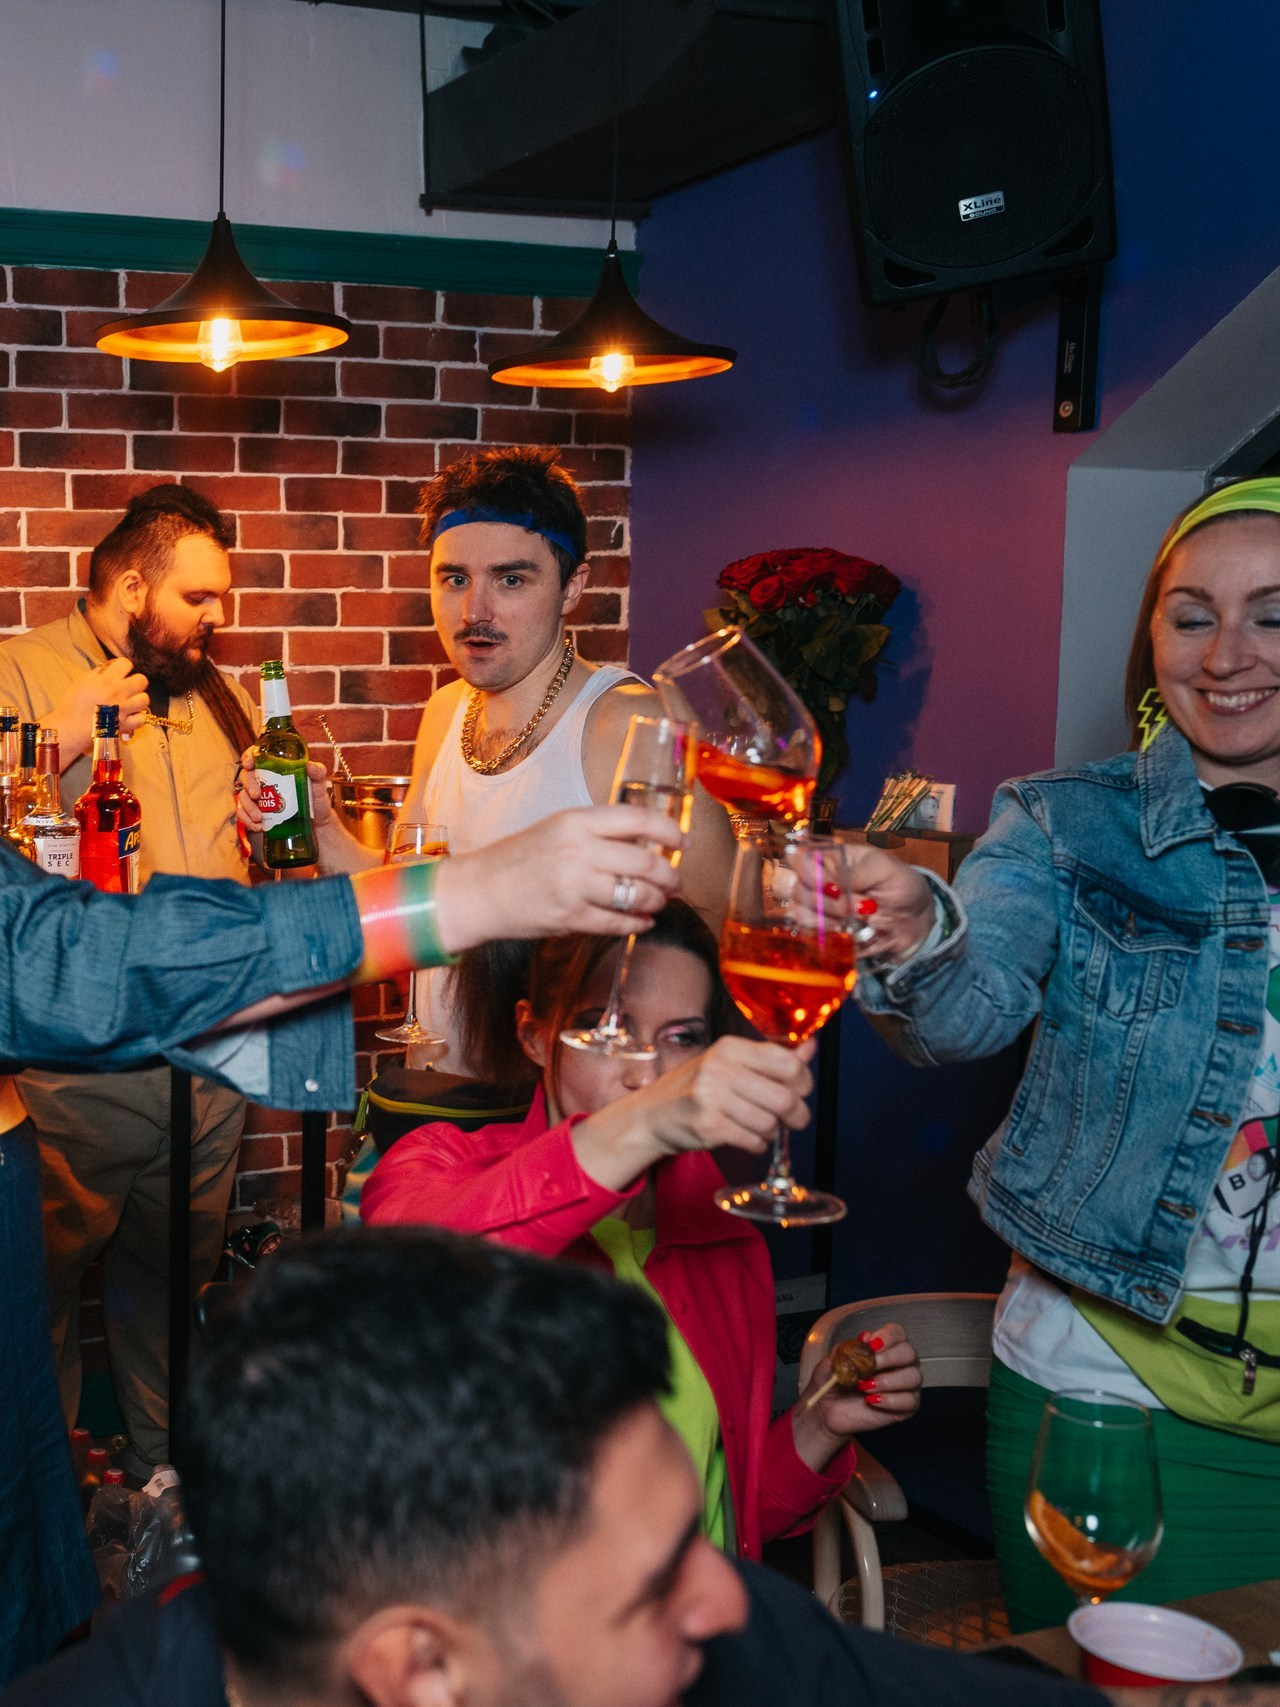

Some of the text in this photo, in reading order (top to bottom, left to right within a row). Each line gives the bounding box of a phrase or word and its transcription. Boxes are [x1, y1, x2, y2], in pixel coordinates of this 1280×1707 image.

[963, 198, 1001, 211] XLine
[969, 208, 997, 218] SOUND
[258, 799, 276, 808] TOIS
